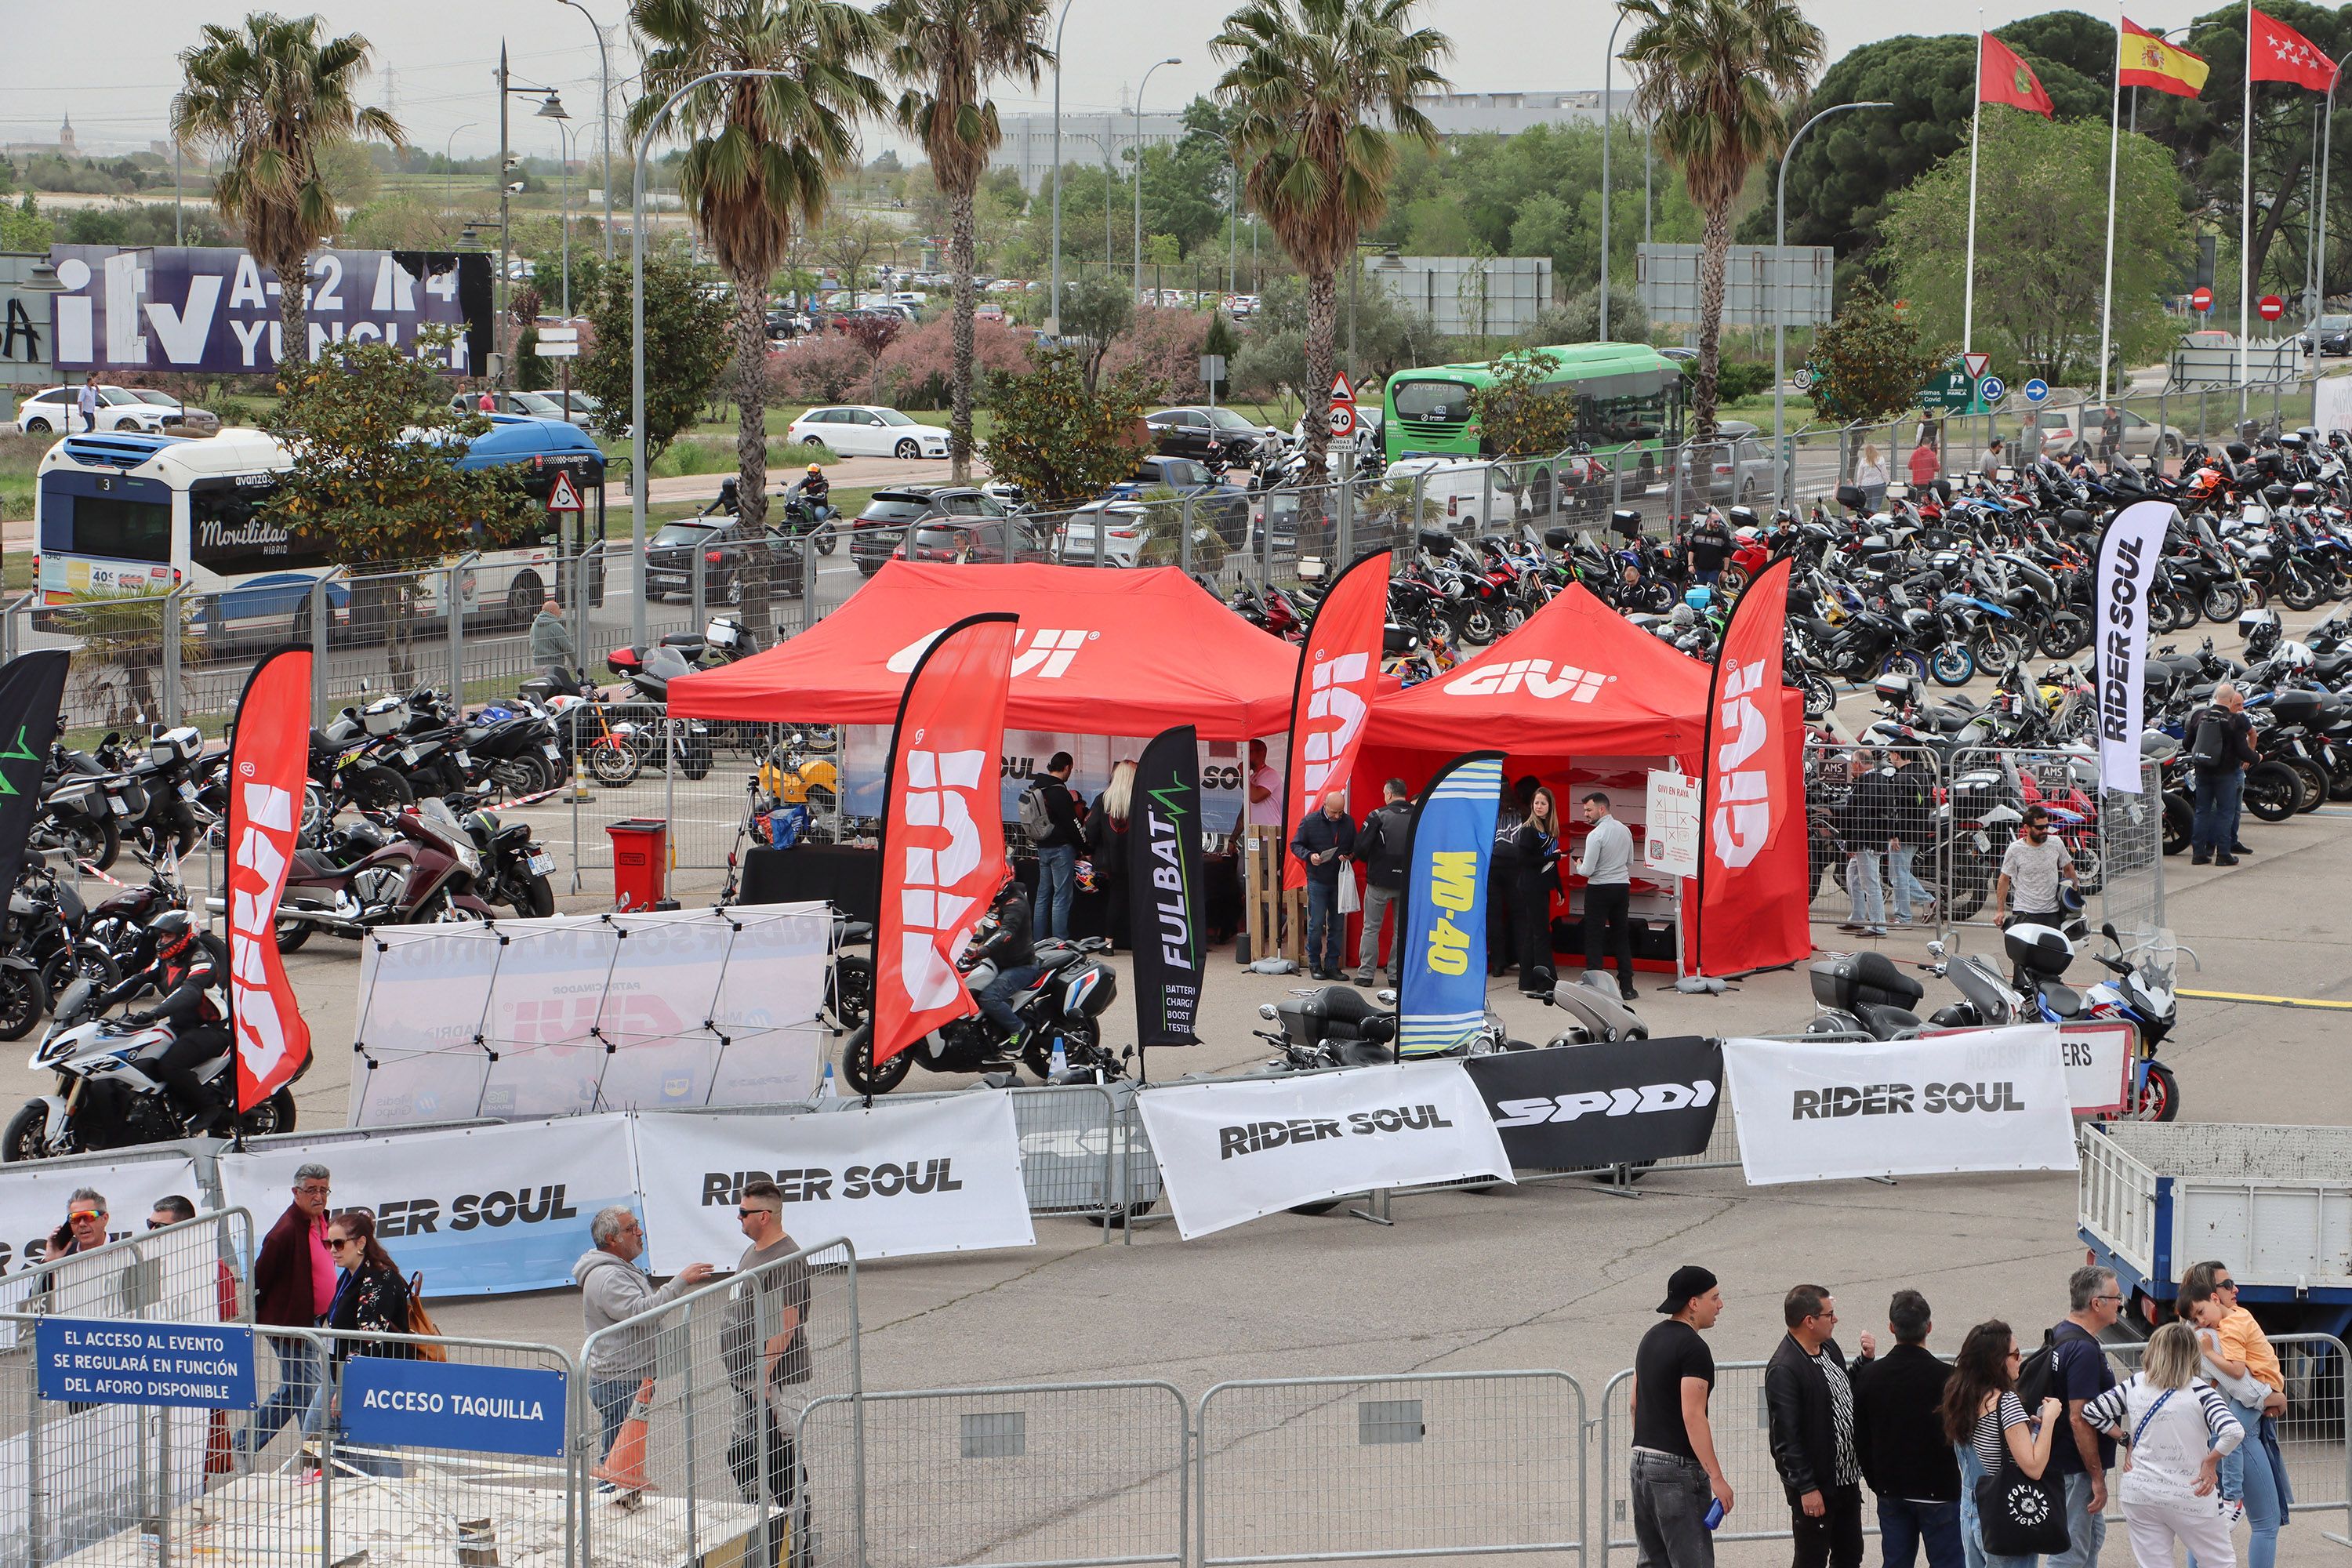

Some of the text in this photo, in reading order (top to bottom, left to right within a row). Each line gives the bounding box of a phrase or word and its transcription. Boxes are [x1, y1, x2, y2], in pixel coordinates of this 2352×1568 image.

[1413, 383, 1449, 392] avanza
[1331, 413, 1348, 426] 40
[103, 479, 110, 491] 3
[235, 474, 267, 487] avanza
[2109, 535, 2143, 630] SOUL
[1443, 659, 1607, 703] GIVI
[2104, 630, 2132, 743] RIDER
[662, 719, 681, 728] AS
[1712, 658, 1770, 869] GIVI
[1824, 763, 1843, 773] AMS
[2043, 767, 2063, 777] AMS
[1657, 784, 1690, 799] GIVI EN RAYA
[534, 855, 549, 865] 3313
[535, 862, 549, 872] LNG
[900, 749, 986, 1014] GIVI
[1149, 811, 1192, 970] FULBAT
[1427, 851, 1478, 976] WD-40
[1496, 1080, 1716, 1128] SPIDI
[1792, 1082, 2026, 1120] RIDER SOUL
[1220, 1104, 1453, 1161] RIDER SOUL
[841, 1158, 963, 1200] SOUL
[449, 1184, 578, 1232] SOUL
[64, 1331, 224, 1352] EL ACCESO AL EVENTO
[53, 1354, 238, 1377] SE REGULARÁ EN FUNCIÓN
[64, 1377, 230, 1399] DEL AFORO DISPONIBLE
[363, 1388, 544, 1421] ACCESO TAQUILLA
[2007, 1484, 2045, 1501] FOKIN
